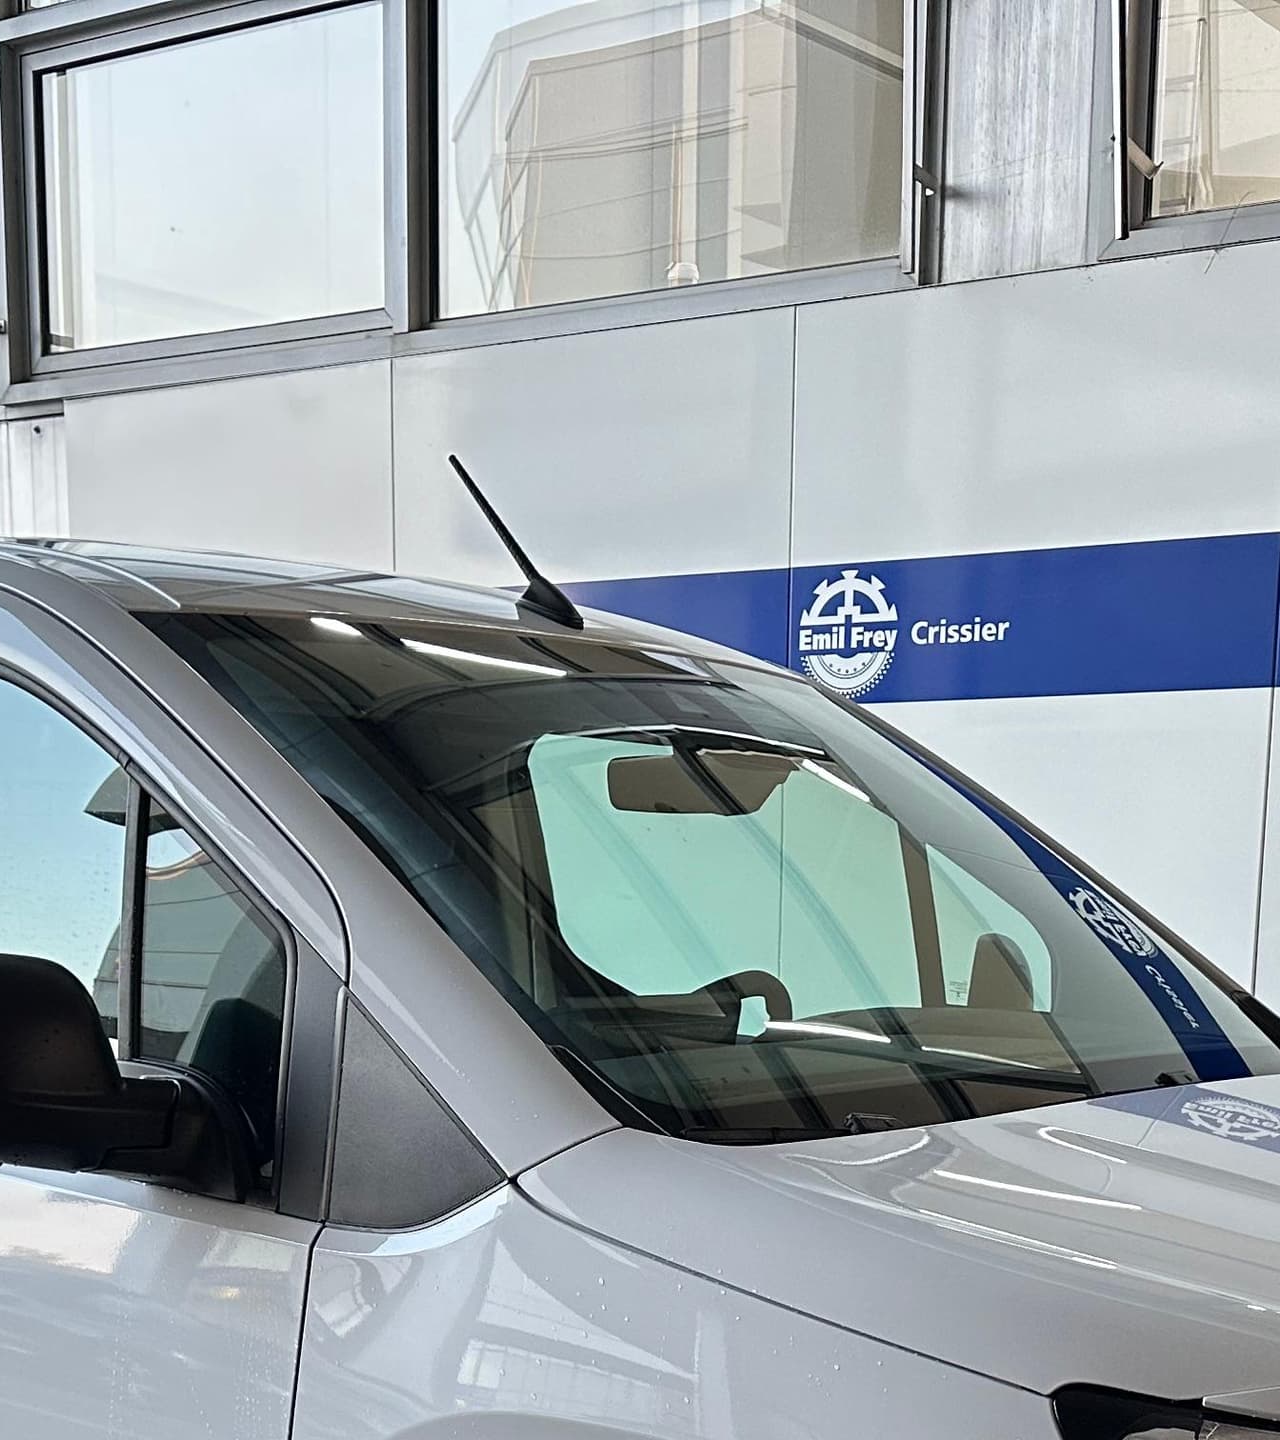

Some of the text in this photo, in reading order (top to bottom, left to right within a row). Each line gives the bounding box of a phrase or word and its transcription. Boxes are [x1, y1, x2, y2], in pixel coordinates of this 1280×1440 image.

[799, 626, 898, 651] Emil Frey
[910, 617, 1010, 645] Crissier
